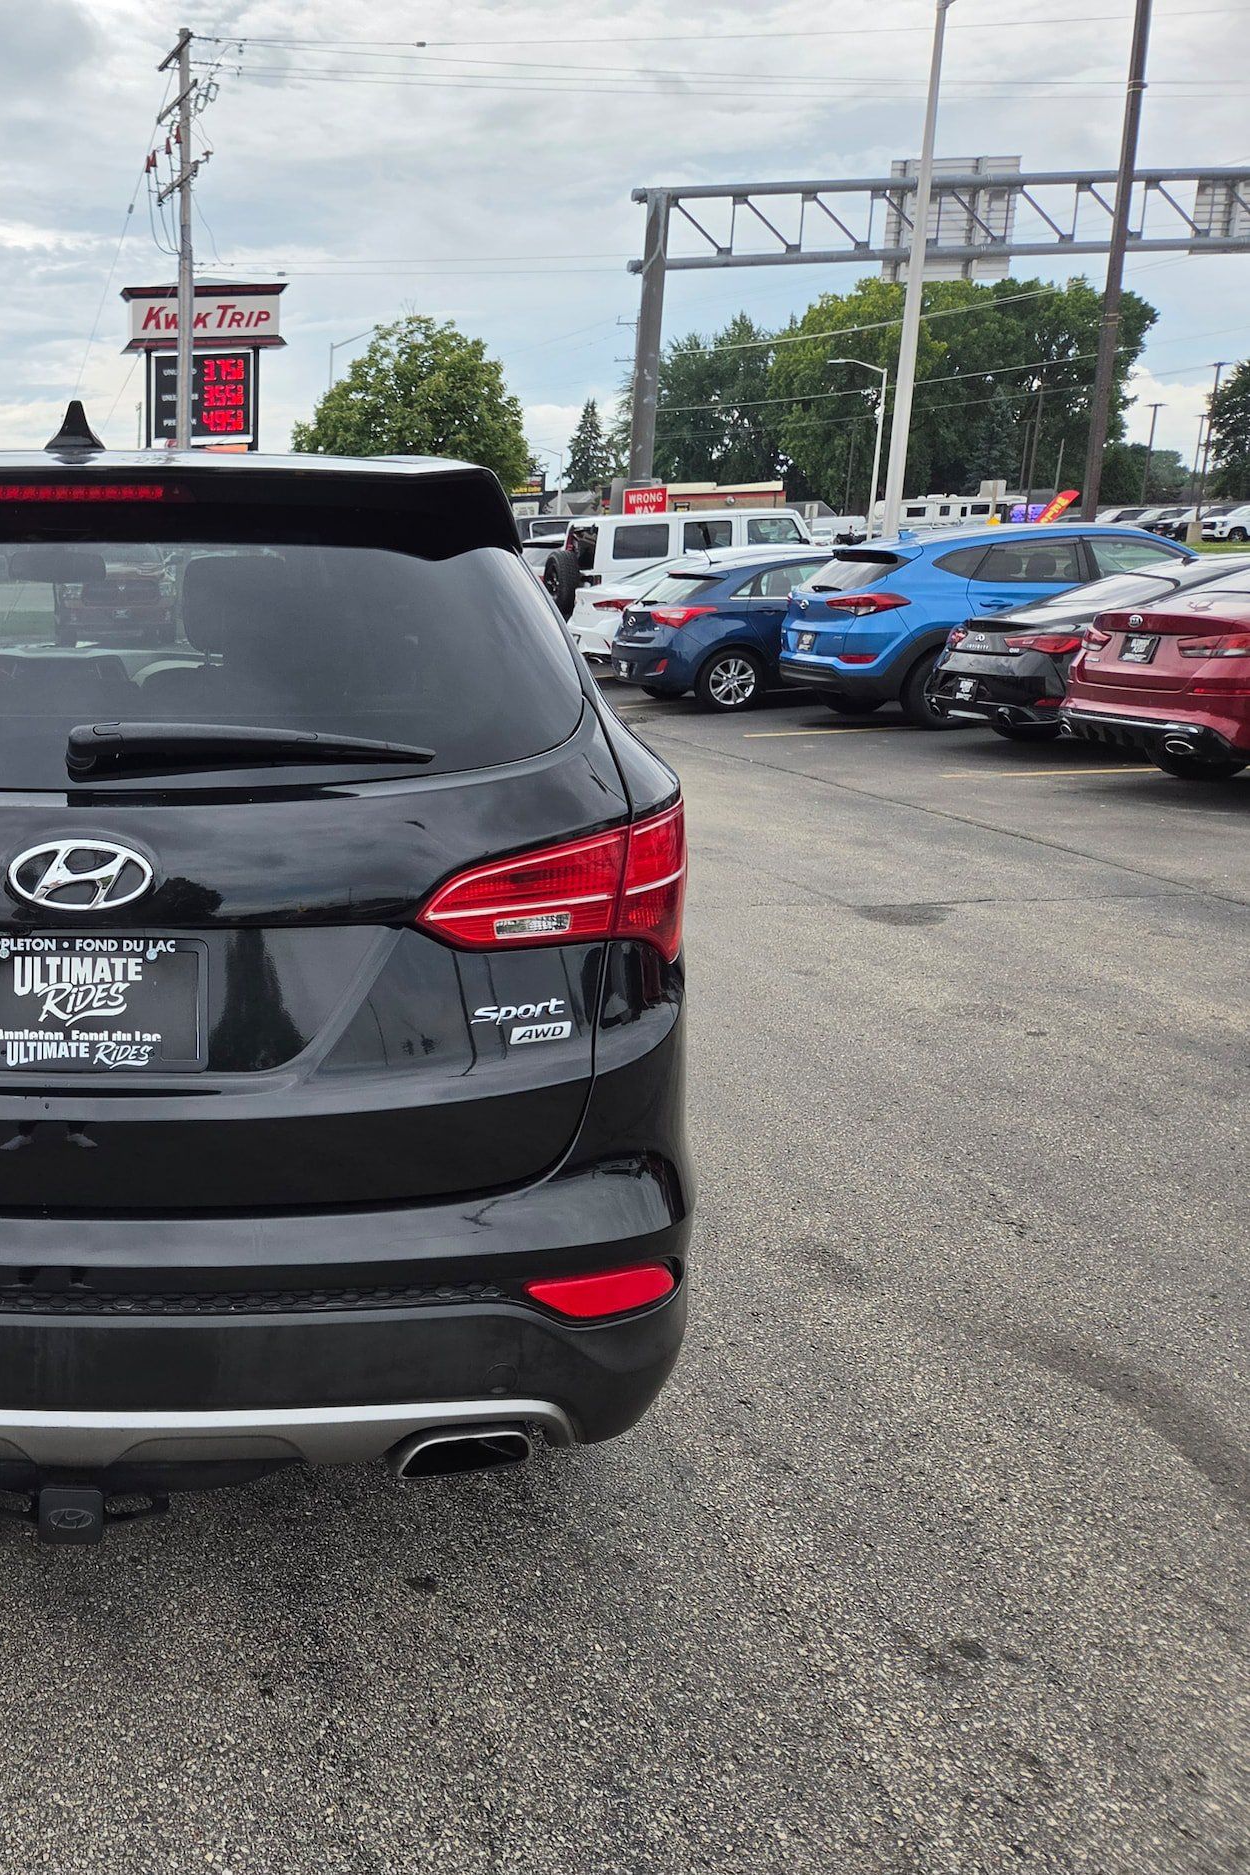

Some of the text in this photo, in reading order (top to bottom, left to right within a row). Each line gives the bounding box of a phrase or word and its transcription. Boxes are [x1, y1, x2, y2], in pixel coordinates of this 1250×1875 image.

[142, 304, 271, 331] KWK TRIP
[628, 491, 663, 505] WRONG
[634, 505, 656, 515] WAY
[75, 938, 118, 952] FOND
[122, 939, 144, 953] DU
[148, 940, 176, 953] LAC
[13, 956, 143, 997] ULTIMATE
[470, 997, 566, 1026] Sport
[517, 1025, 564, 1041] AWD
[6, 1041, 90, 1068] ULTIMATE
